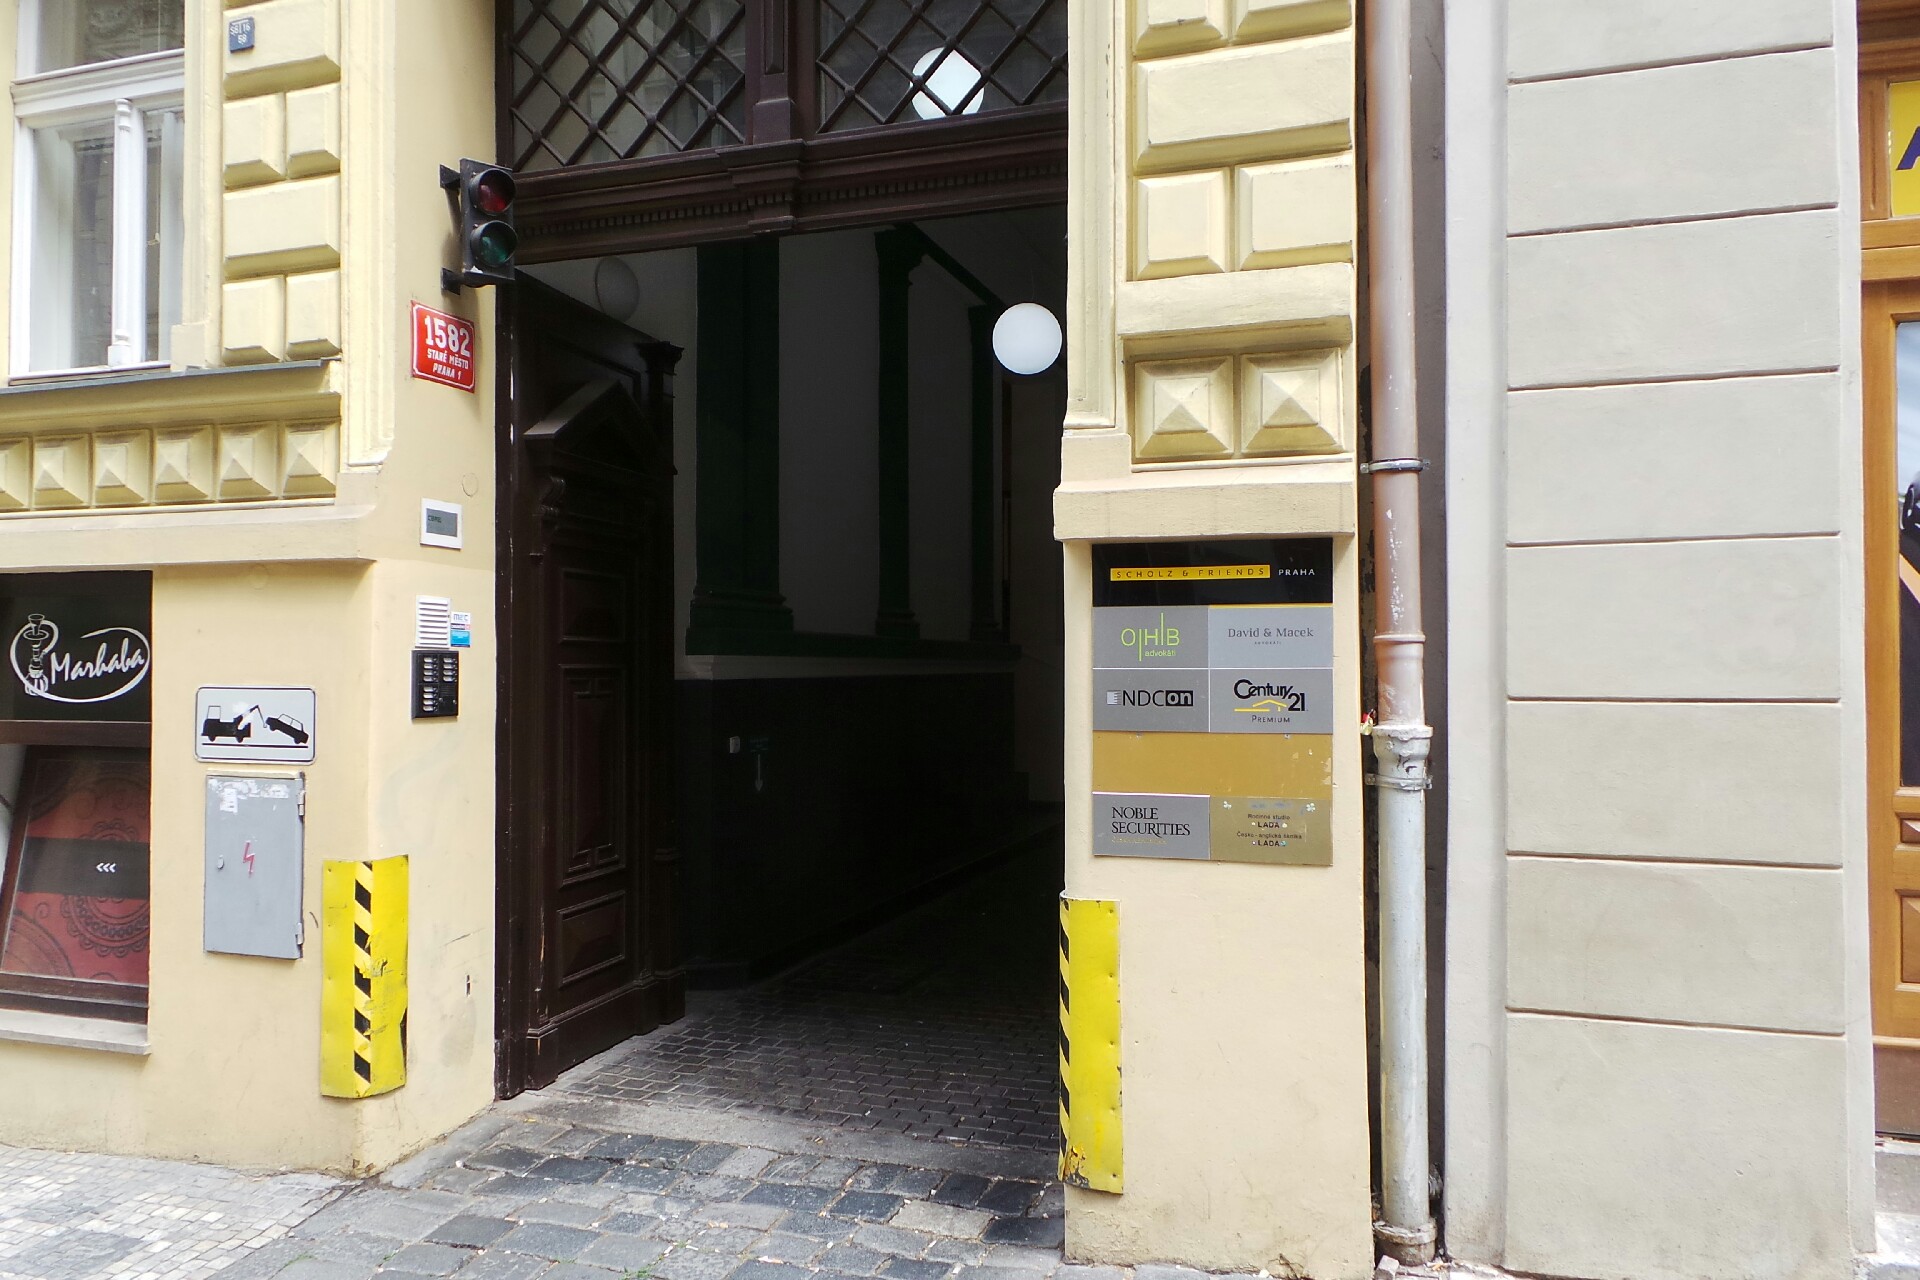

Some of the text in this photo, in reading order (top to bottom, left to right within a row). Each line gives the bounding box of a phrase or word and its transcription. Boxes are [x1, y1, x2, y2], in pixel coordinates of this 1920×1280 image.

[424, 315, 471, 357] 1582
[427, 348, 469, 370] STARÉ MĚSTO
[432, 362, 462, 380] PRAHA 1
[1116, 570, 1173, 578] SCHOLZ
[1198, 568, 1265, 577] FRIENDS
[1278, 568, 1316, 577] PRAHA
[1228, 628, 1314, 638] David & Macek
[50, 637, 145, 684] Marhaba
[1144, 649, 1176, 657] advokáti
[1233, 679, 1294, 700] Century
[1287, 692, 1306, 711] 21
[1111, 806, 1159, 819] NOBLE
[1111, 821, 1191, 838] SECURITIES
